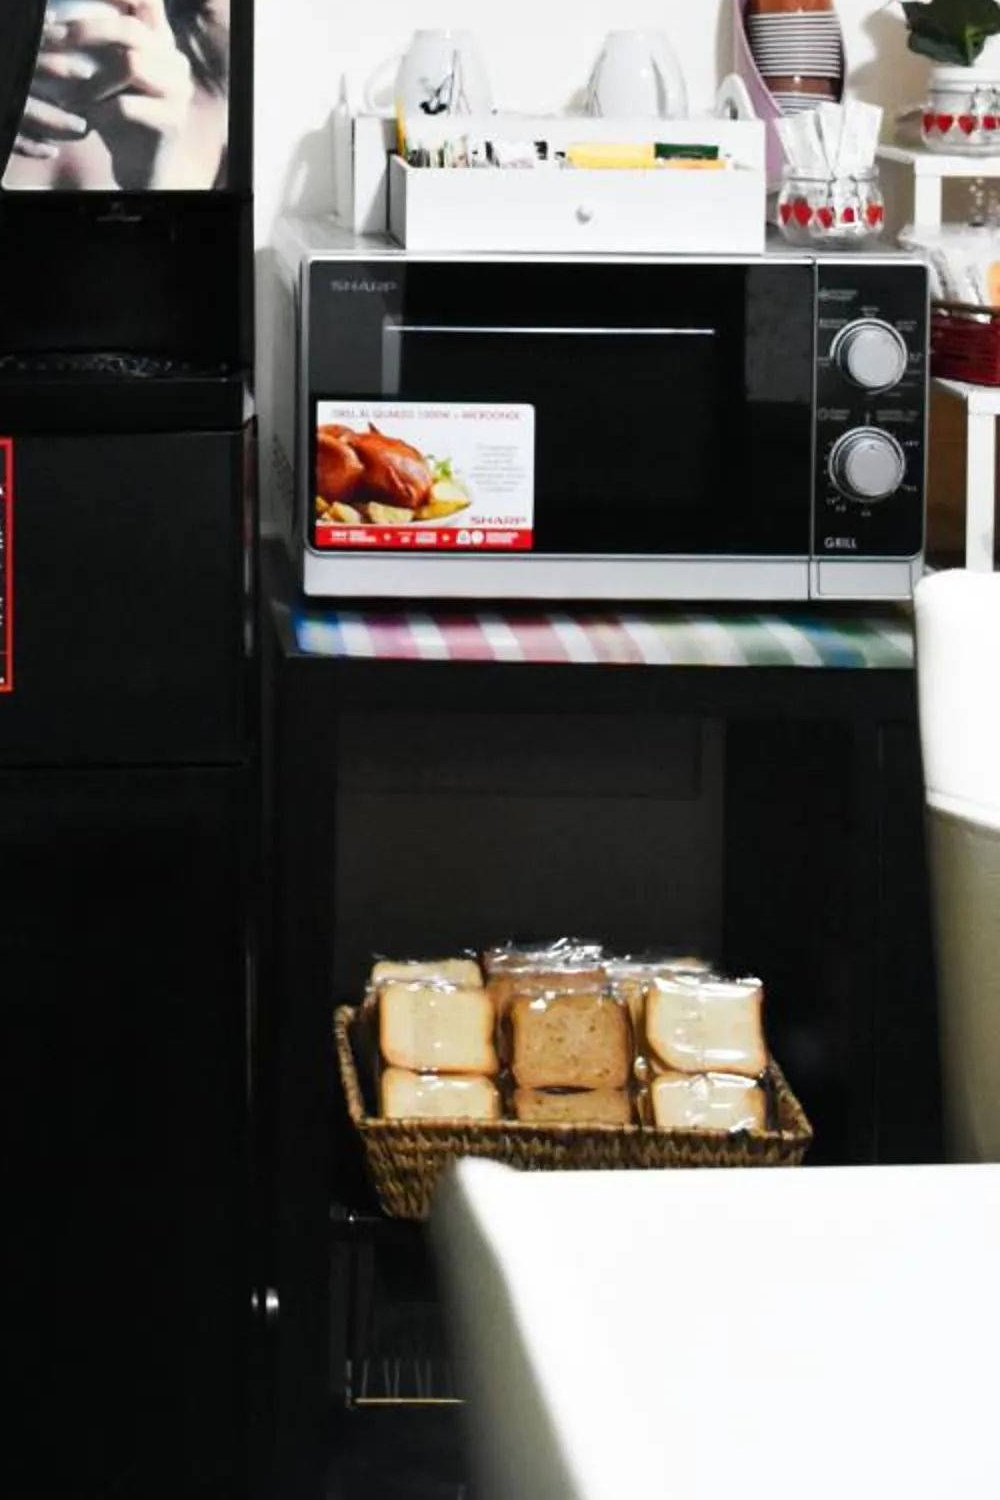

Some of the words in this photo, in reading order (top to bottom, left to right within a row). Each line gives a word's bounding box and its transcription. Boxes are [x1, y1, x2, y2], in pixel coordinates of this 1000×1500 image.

[330, 279, 398, 292] SHARP
[470, 516, 526, 525] SHARP
[824, 536, 857, 549] GRILL
